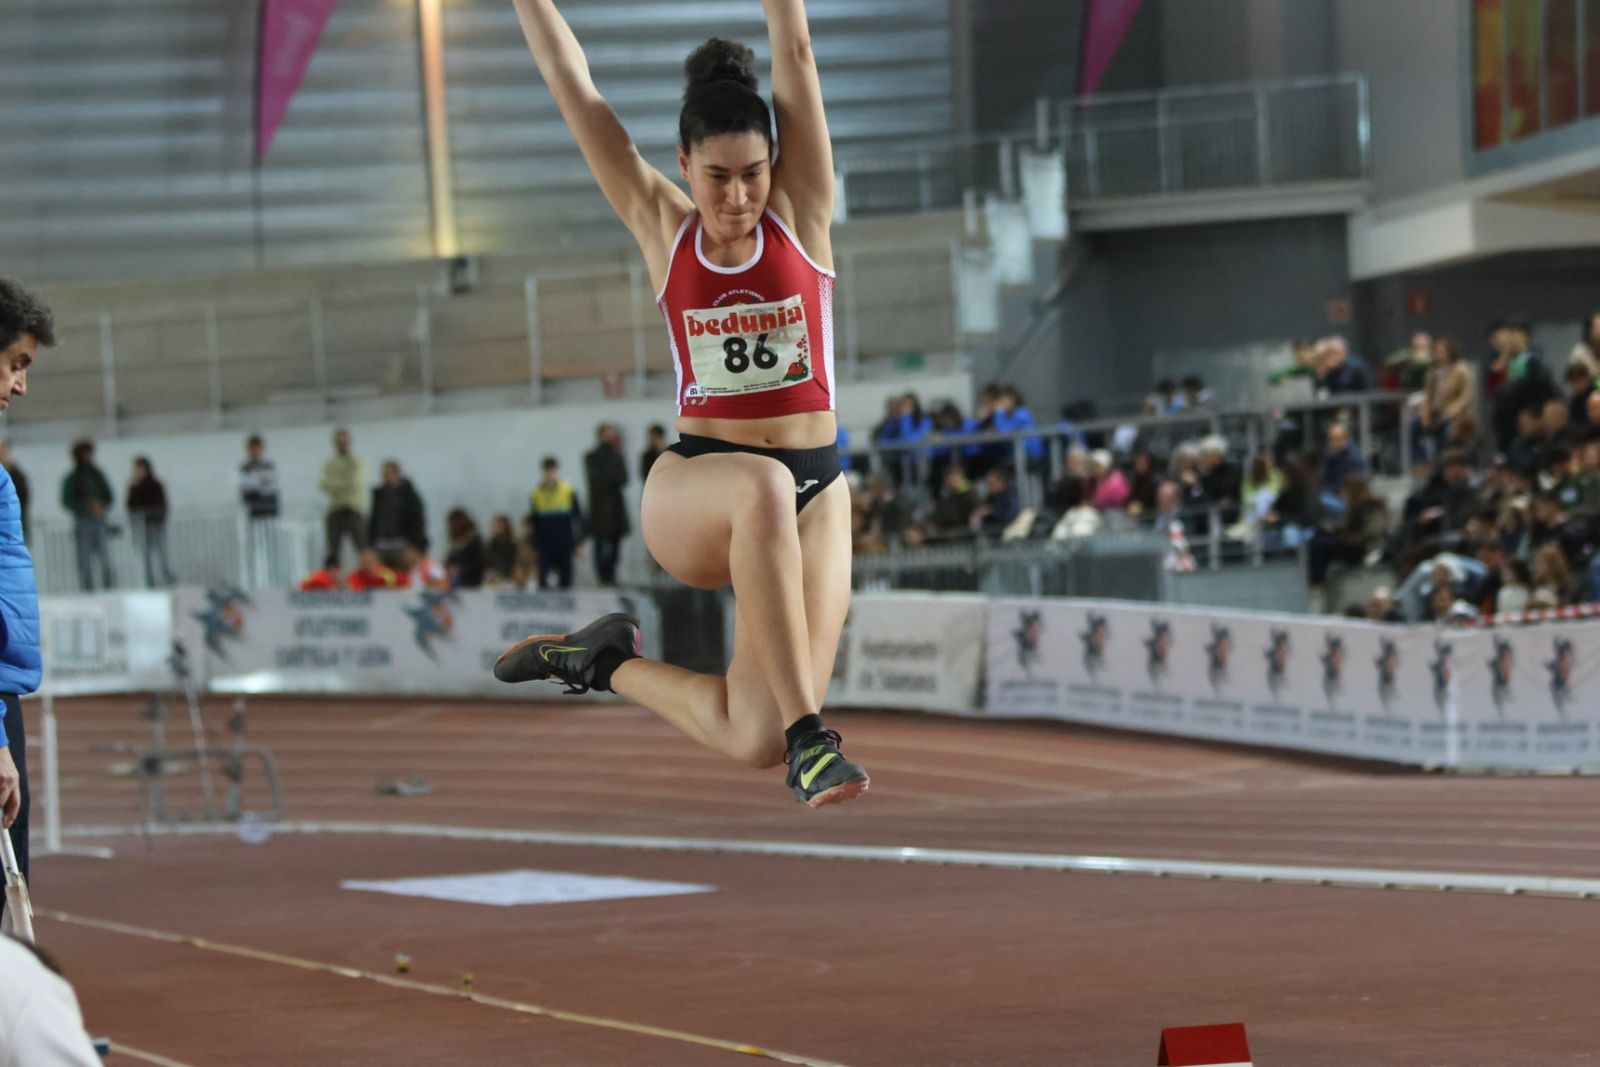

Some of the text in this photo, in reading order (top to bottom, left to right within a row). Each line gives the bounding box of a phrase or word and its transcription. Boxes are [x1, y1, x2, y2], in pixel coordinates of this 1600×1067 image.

[712, 288, 766, 307] CLUB ATLETISMO
[686, 305, 803, 337] bedunia
[723, 333, 778, 374] 86
